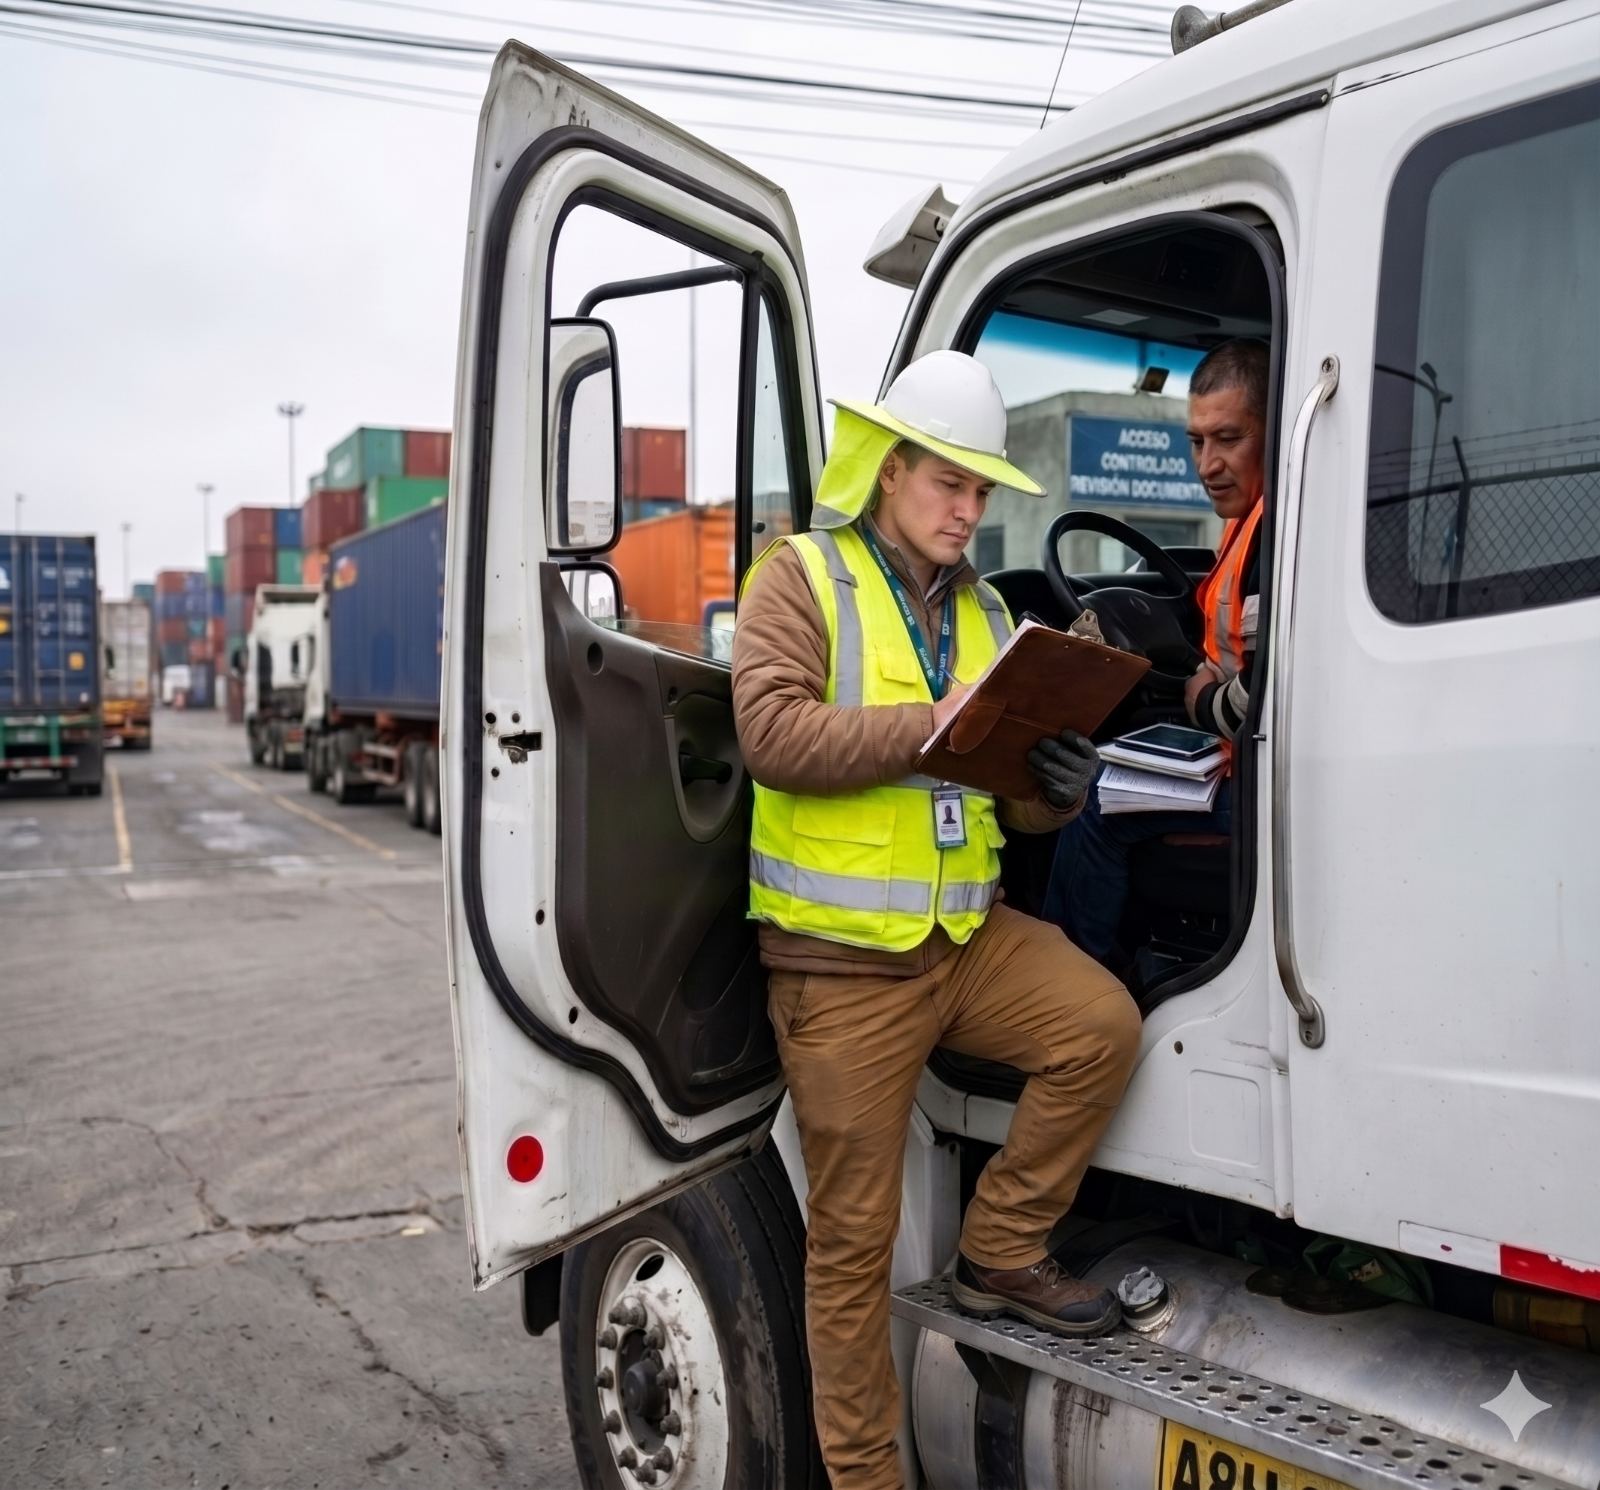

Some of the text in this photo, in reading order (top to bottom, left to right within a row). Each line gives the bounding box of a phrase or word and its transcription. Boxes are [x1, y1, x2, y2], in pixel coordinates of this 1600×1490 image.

[1119, 428, 1170, 450] ACCESO
[1101, 452, 1187, 476] CONTROLADO
[1070, 474, 1130, 496] REVISIÓN
